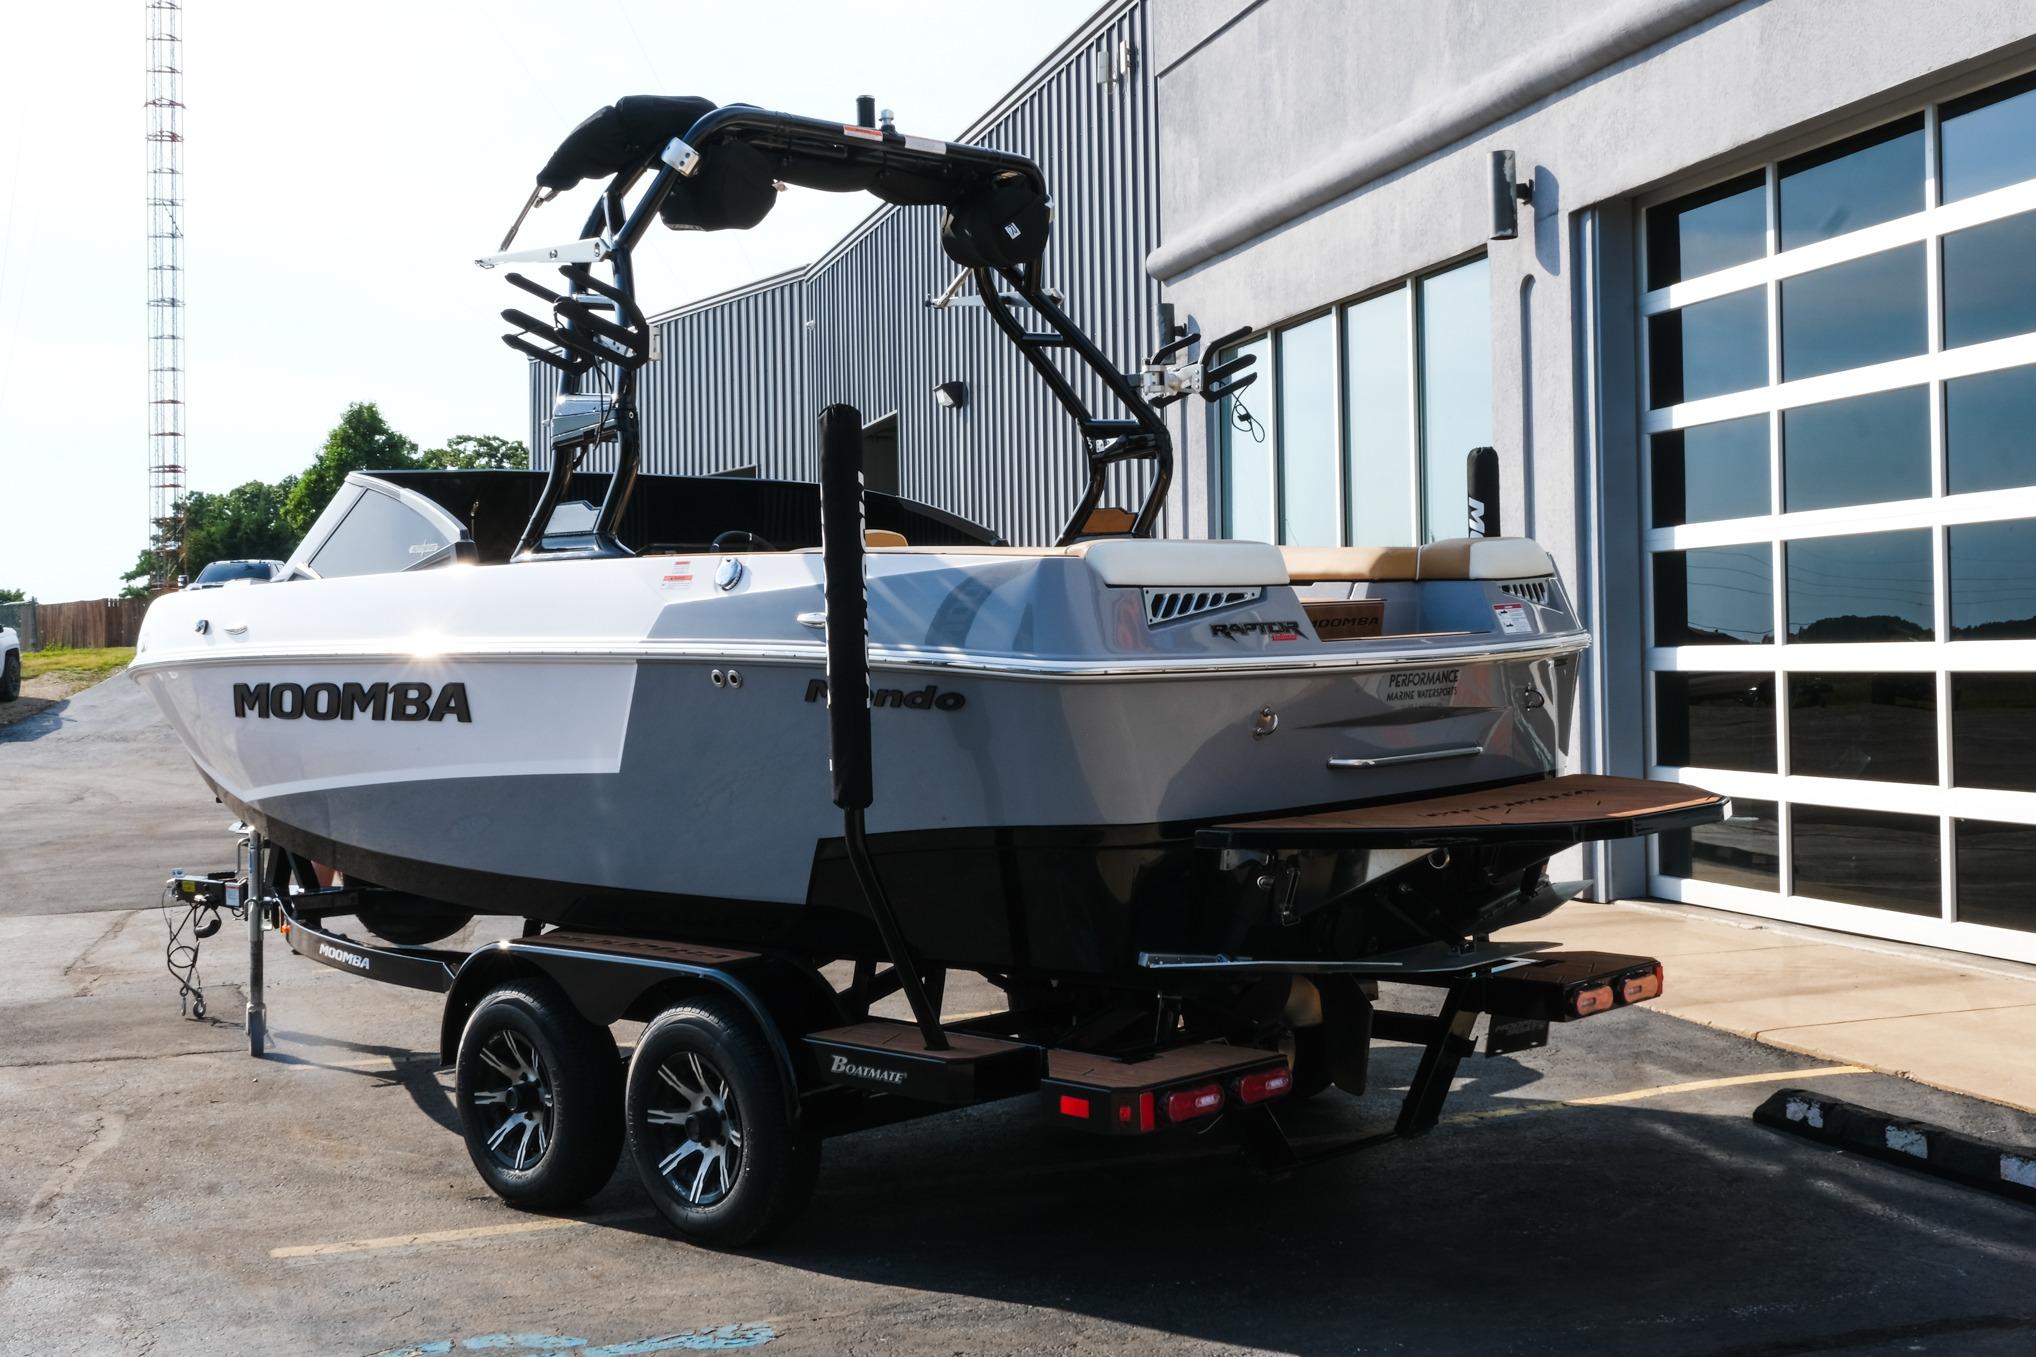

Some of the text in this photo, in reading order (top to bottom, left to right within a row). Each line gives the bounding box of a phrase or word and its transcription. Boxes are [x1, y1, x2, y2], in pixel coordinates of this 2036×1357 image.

[1209, 621, 1309, 643] RAPTOR
[1389, 669, 1459, 688] PERFORMANCE
[233, 682, 472, 723] MOOMBA
[804, 679, 967, 711] Mndo
[1387, 687, 1457, 702] MARINE WATERSPORTS
[319, 943, 370, 970] MOOMBA
